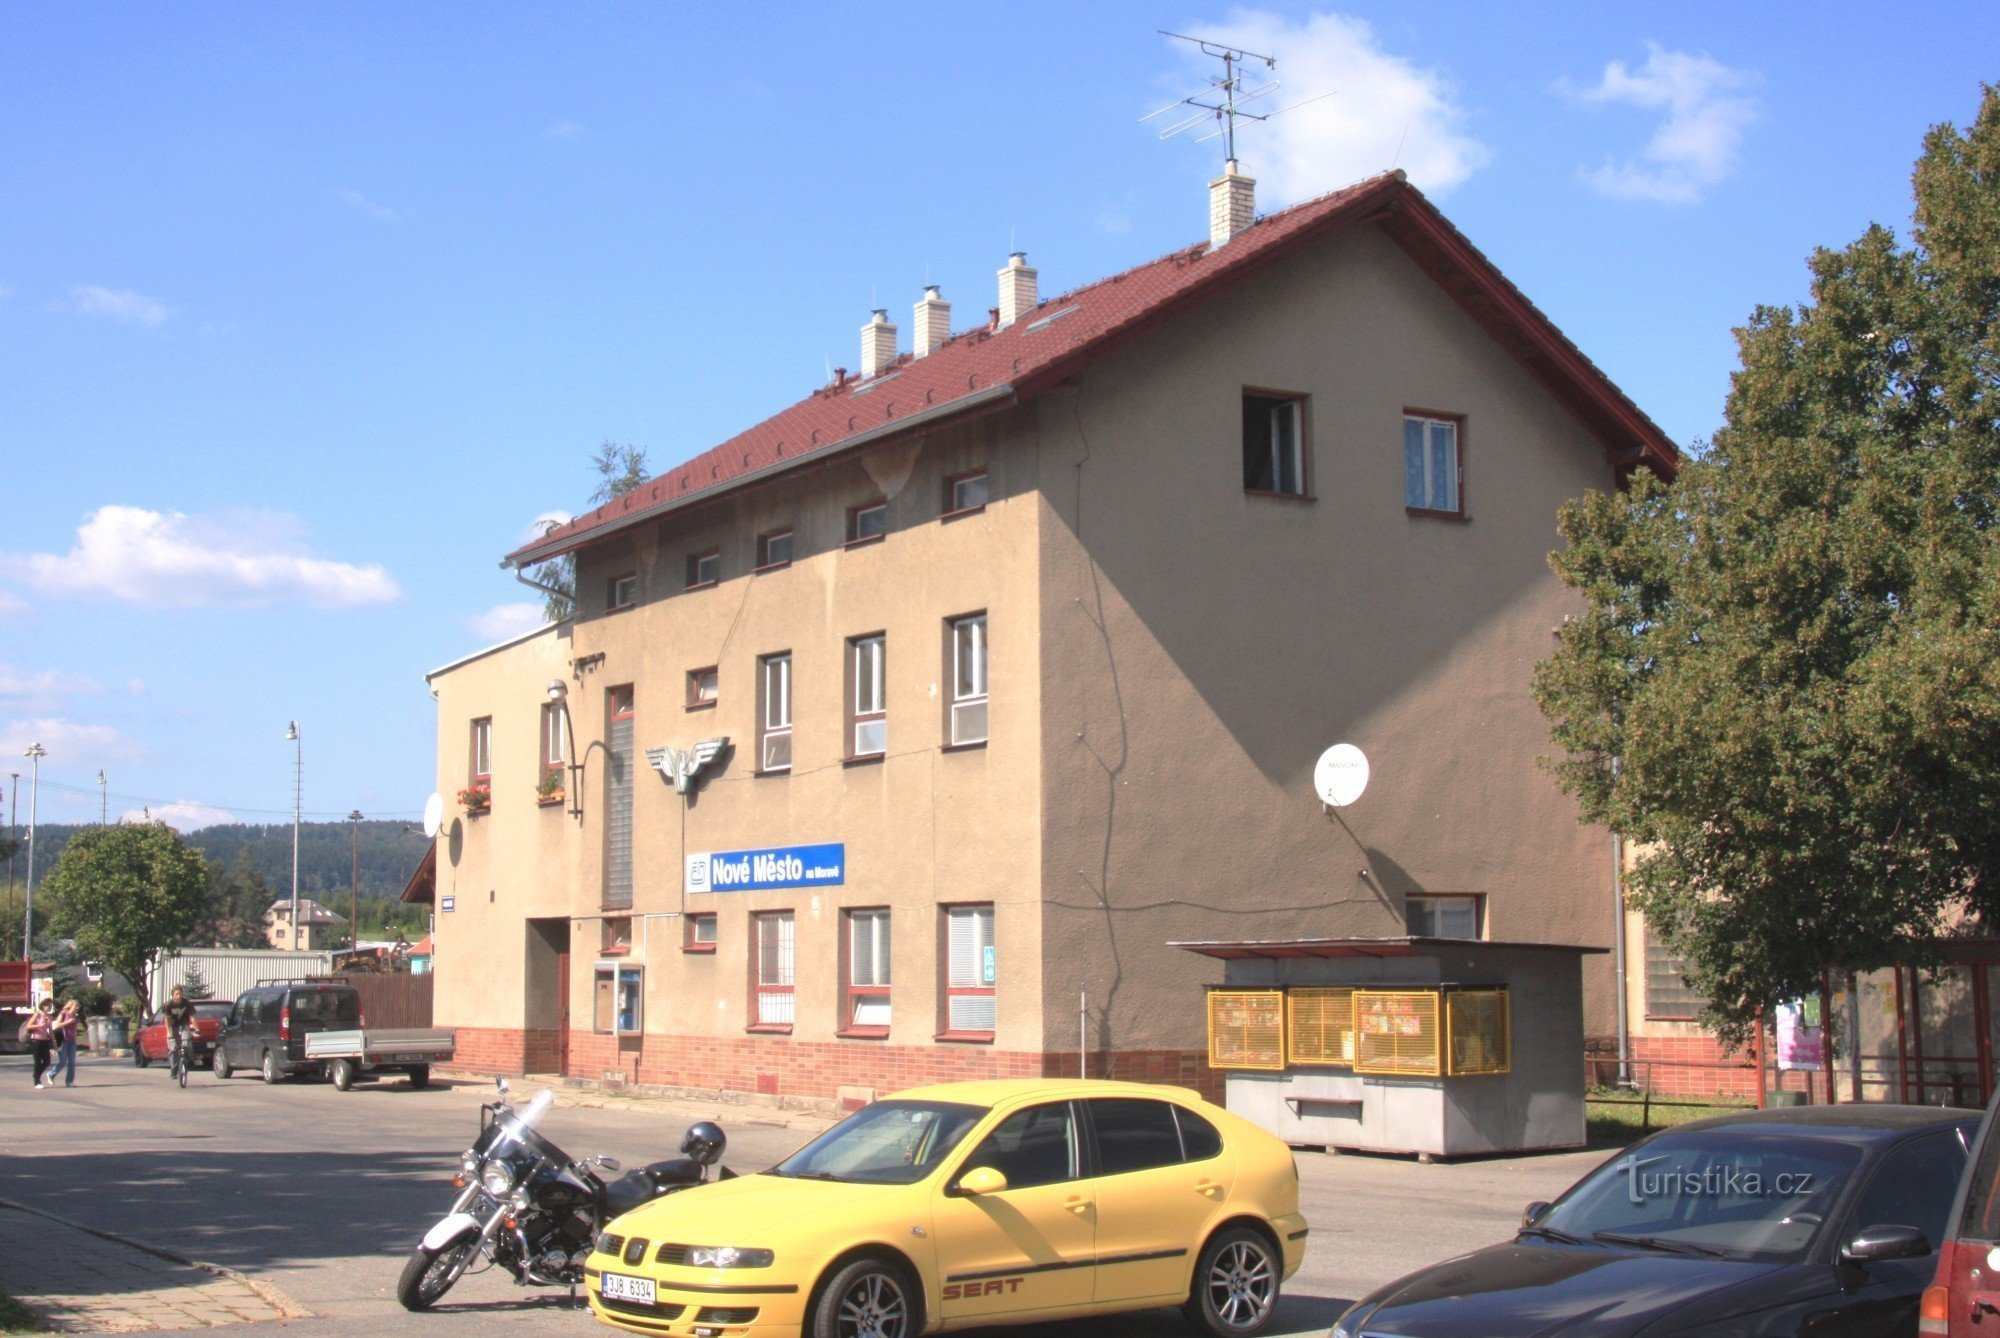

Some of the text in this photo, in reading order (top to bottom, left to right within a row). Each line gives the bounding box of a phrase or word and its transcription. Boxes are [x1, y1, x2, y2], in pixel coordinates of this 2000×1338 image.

[713, 855, 750, 884] Nové
[753, 853, 802, 882] Město
[630, 1280, 651, 1298] 6334
[942, 1278, 1024, 1300] SEAT
